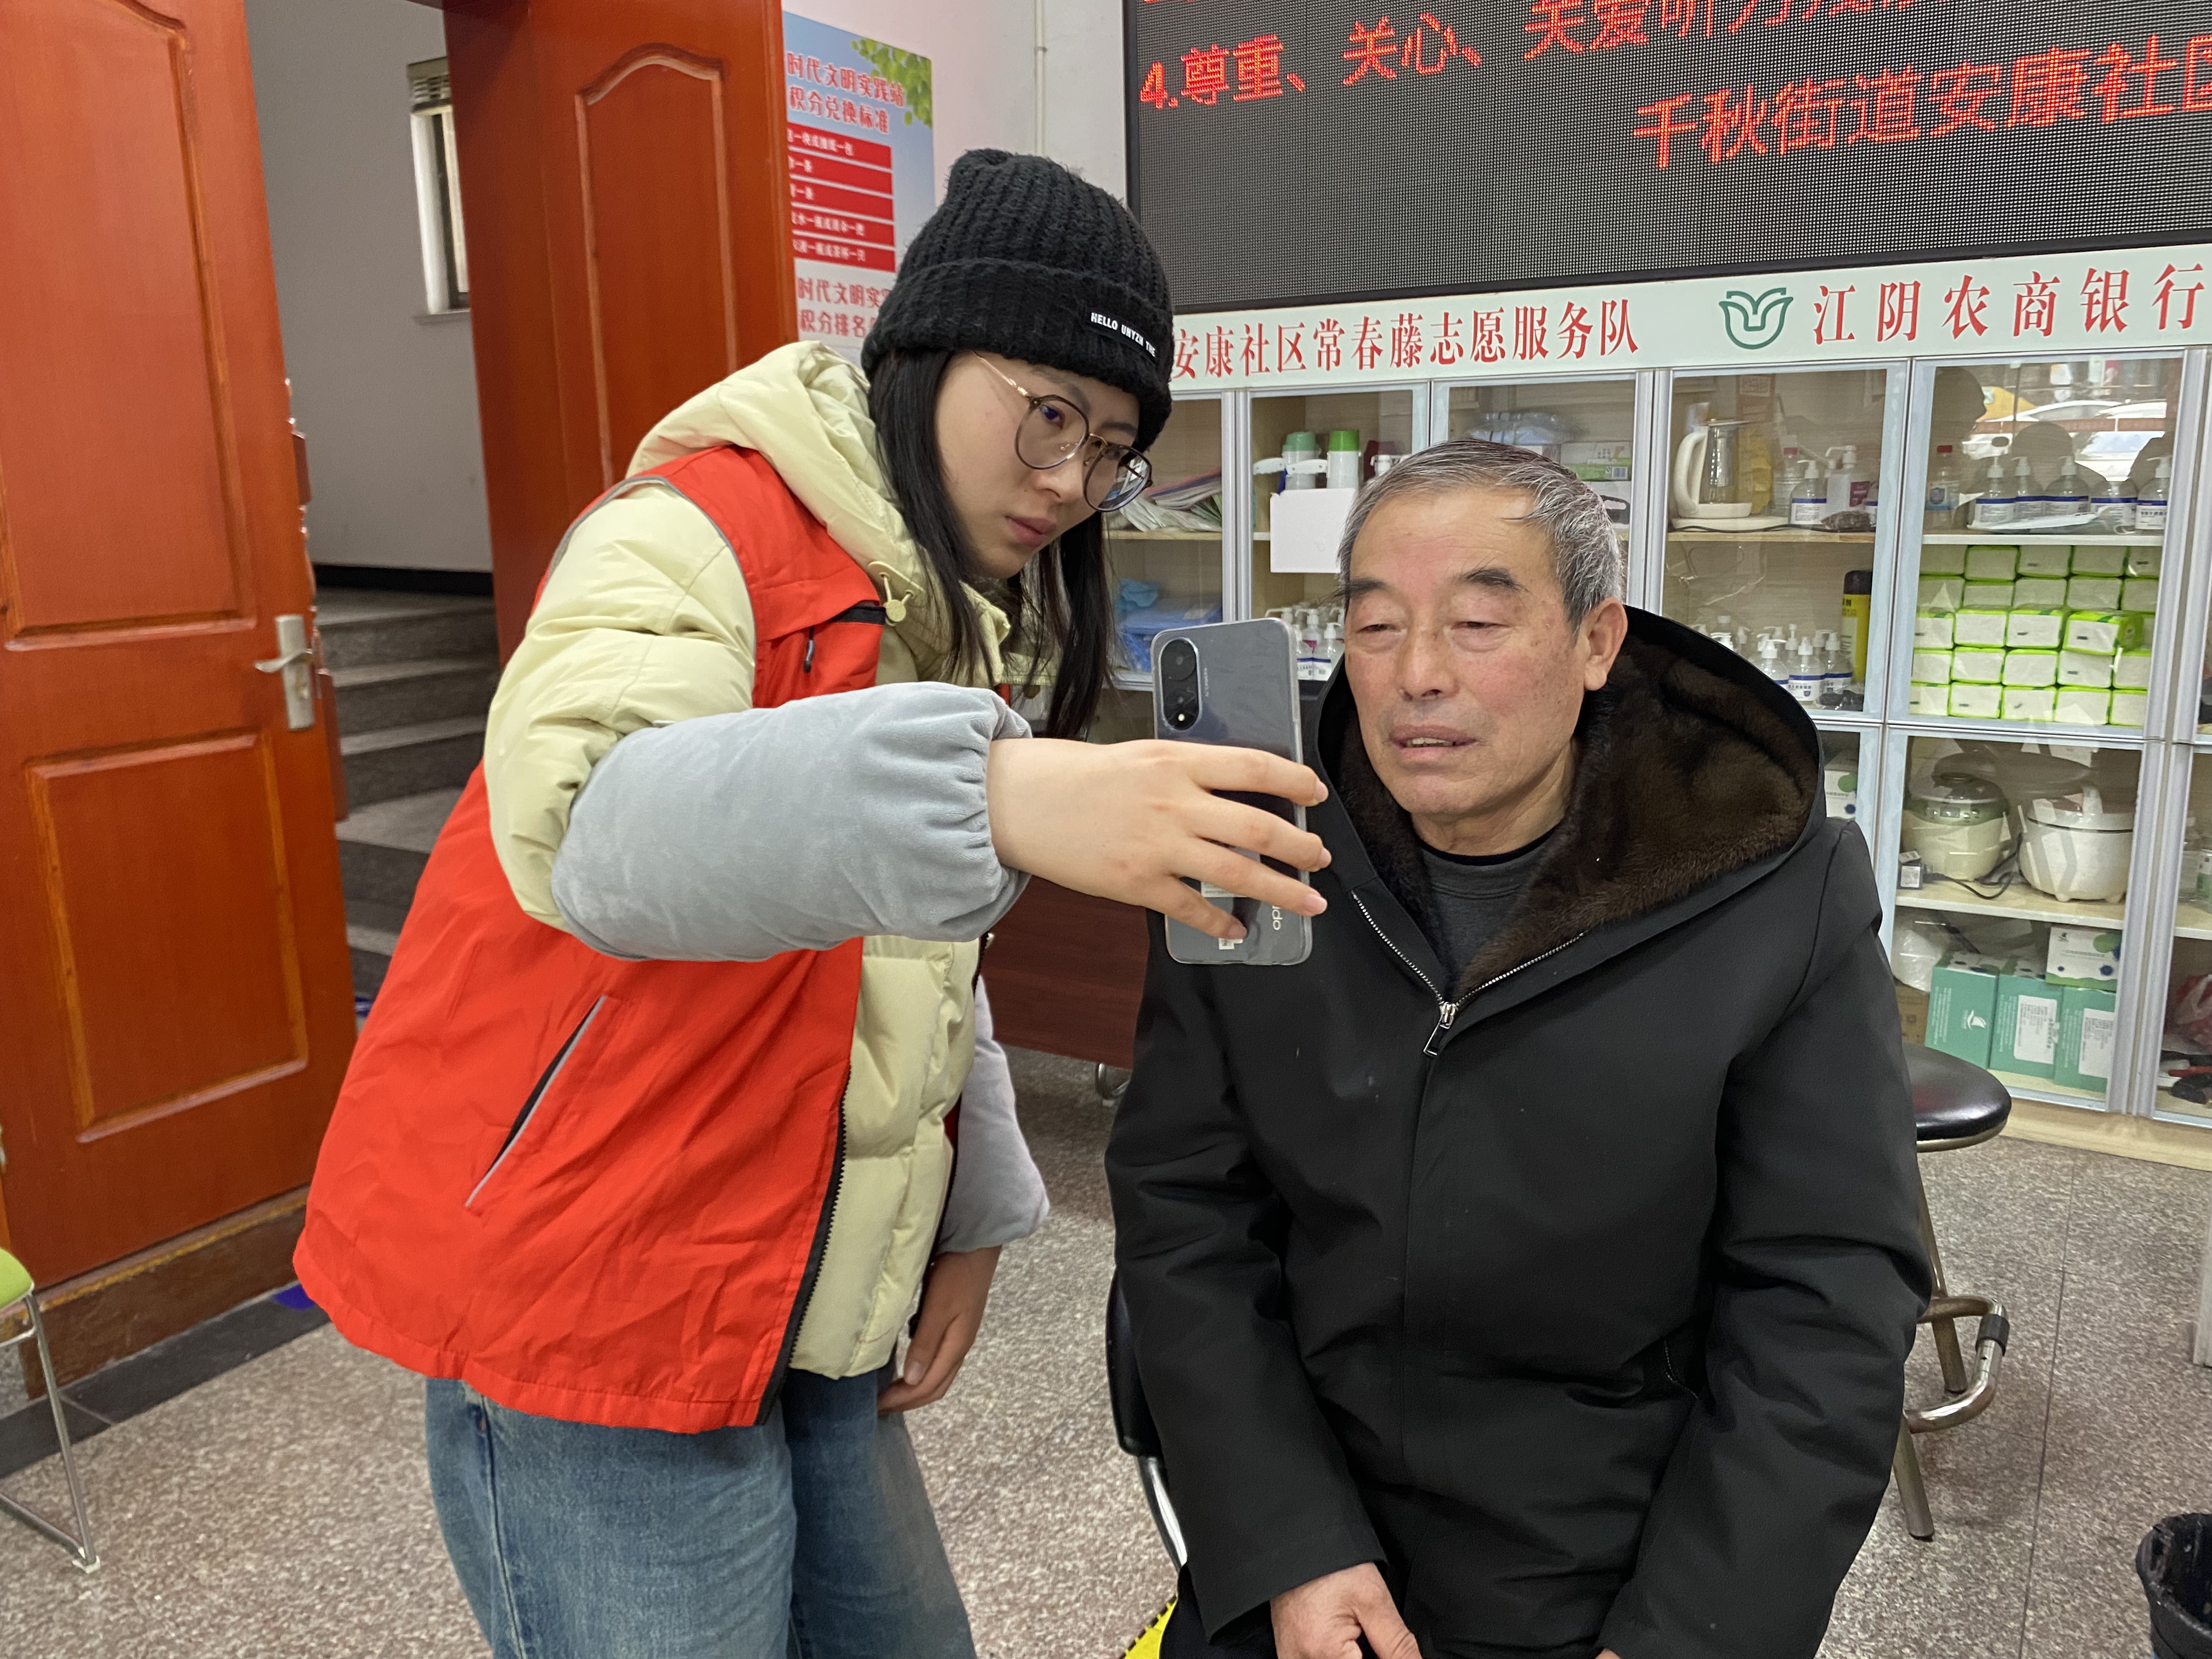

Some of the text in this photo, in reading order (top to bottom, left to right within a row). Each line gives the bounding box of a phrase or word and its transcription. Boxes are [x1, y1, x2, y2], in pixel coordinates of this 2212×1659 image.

[786, 52, 905, 108] 时代文明实践站
[789, 86, 890, 134] 积分兑换标准
[799, 309, 876, 338] 积分排名
[1091, 312, 1118, 330] HELLO
[1813, 263, 2205, 345] 江阴农商银行
[1173, 298, 1640, 379] 安康社区常春藤志愿服务队
